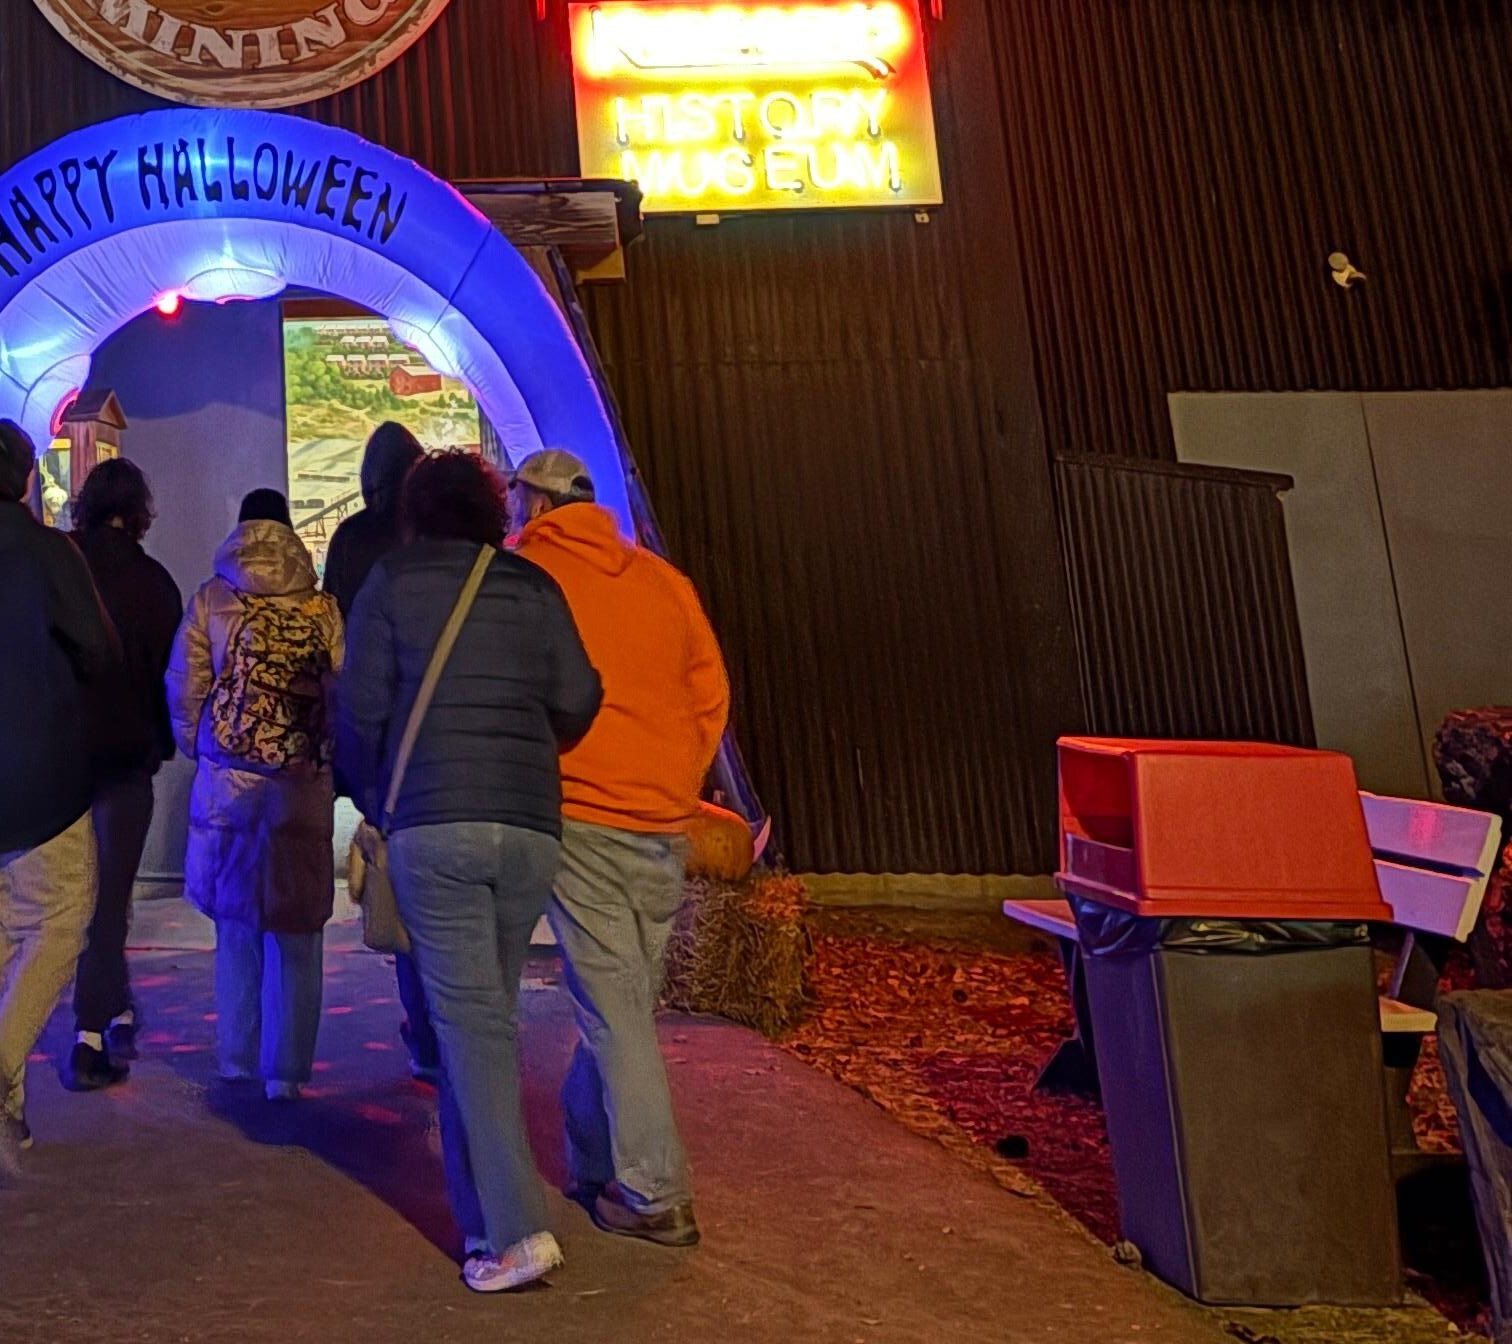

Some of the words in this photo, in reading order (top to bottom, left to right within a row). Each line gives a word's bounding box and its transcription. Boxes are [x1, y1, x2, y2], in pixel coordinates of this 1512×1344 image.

[611, 89, 891, 144] HISTORY
[137, 135, 407, 245] HALLOWEEN
[618, 144, 902, 196] MUSEUM
